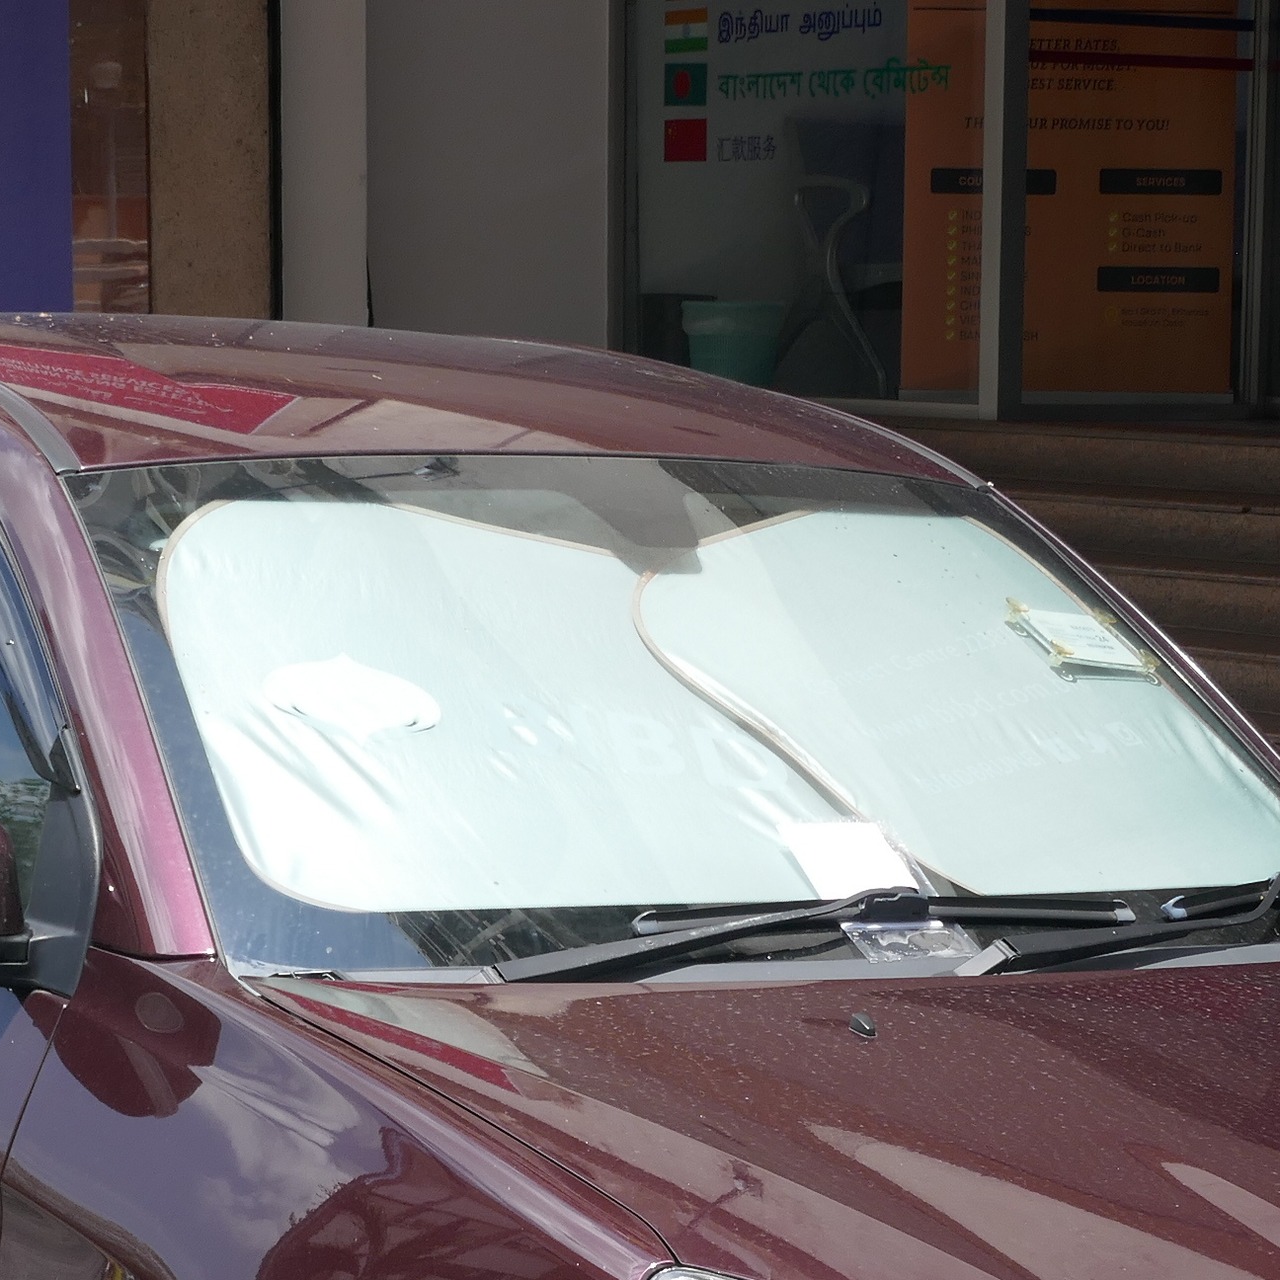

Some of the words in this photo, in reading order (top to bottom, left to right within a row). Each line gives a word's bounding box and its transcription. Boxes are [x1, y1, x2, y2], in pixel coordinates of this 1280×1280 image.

[718, 8, 791, 43] இந்தியா
[800, 2, 883, 41] அனுப்பும்
[1027, 38, 1070, 51] ETTER
[718, 71, 803, 100] বাংলাদেশ
[809, 69, 857, 97] থেকে
[1051, 118, 1110, 130] PROMISE
[1117, 119, 1134, 131] TO
[1139, 119, 1170, 132] YOU!
[718, 135, 778, 161] 汇款服务
[1136, 177, 1186, 187] SERVICES
[1131, 275, 1186, 285] LOCATION
[889, 643, 961, 671] Centre
